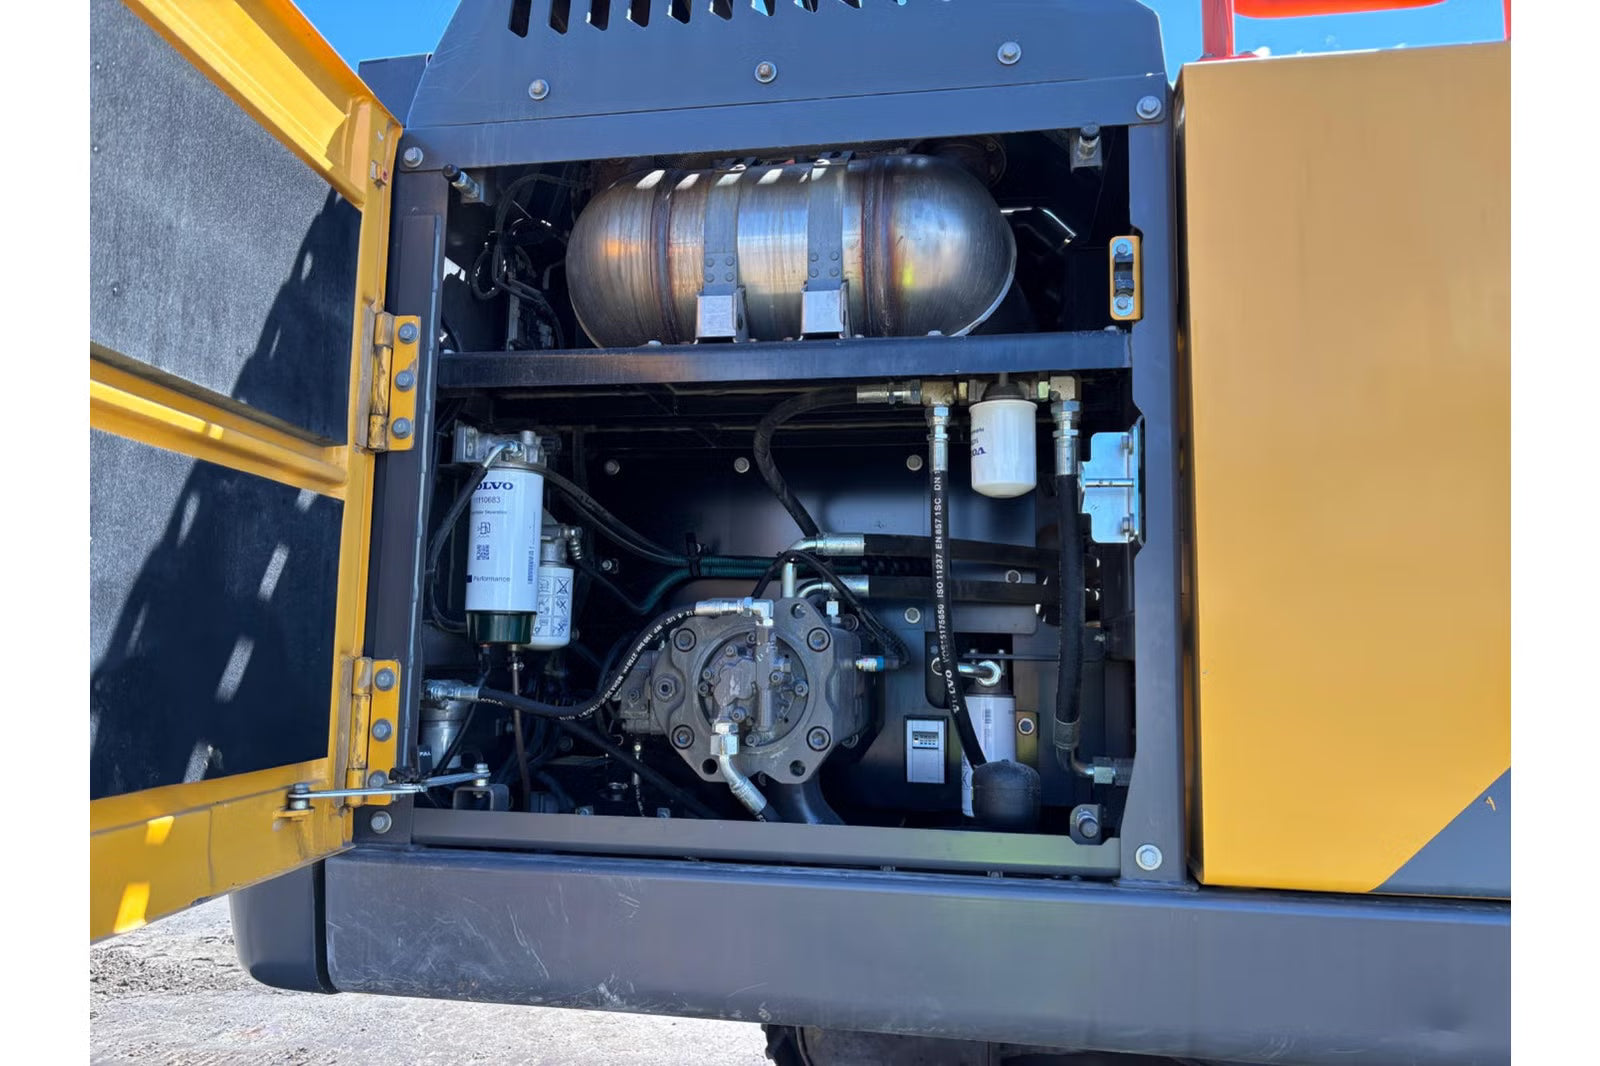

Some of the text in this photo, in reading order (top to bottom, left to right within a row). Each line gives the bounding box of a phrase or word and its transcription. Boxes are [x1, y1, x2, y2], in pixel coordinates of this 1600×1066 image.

[475, 481, 514, 491] OLVO
[933, 476, 942, 491] DN
[933, 497, 942, 516] 1SC
[934, 536, 943, 550] EN
[935, 554, 944, 580] 11237
[936, 581, 944, 598] ISO
